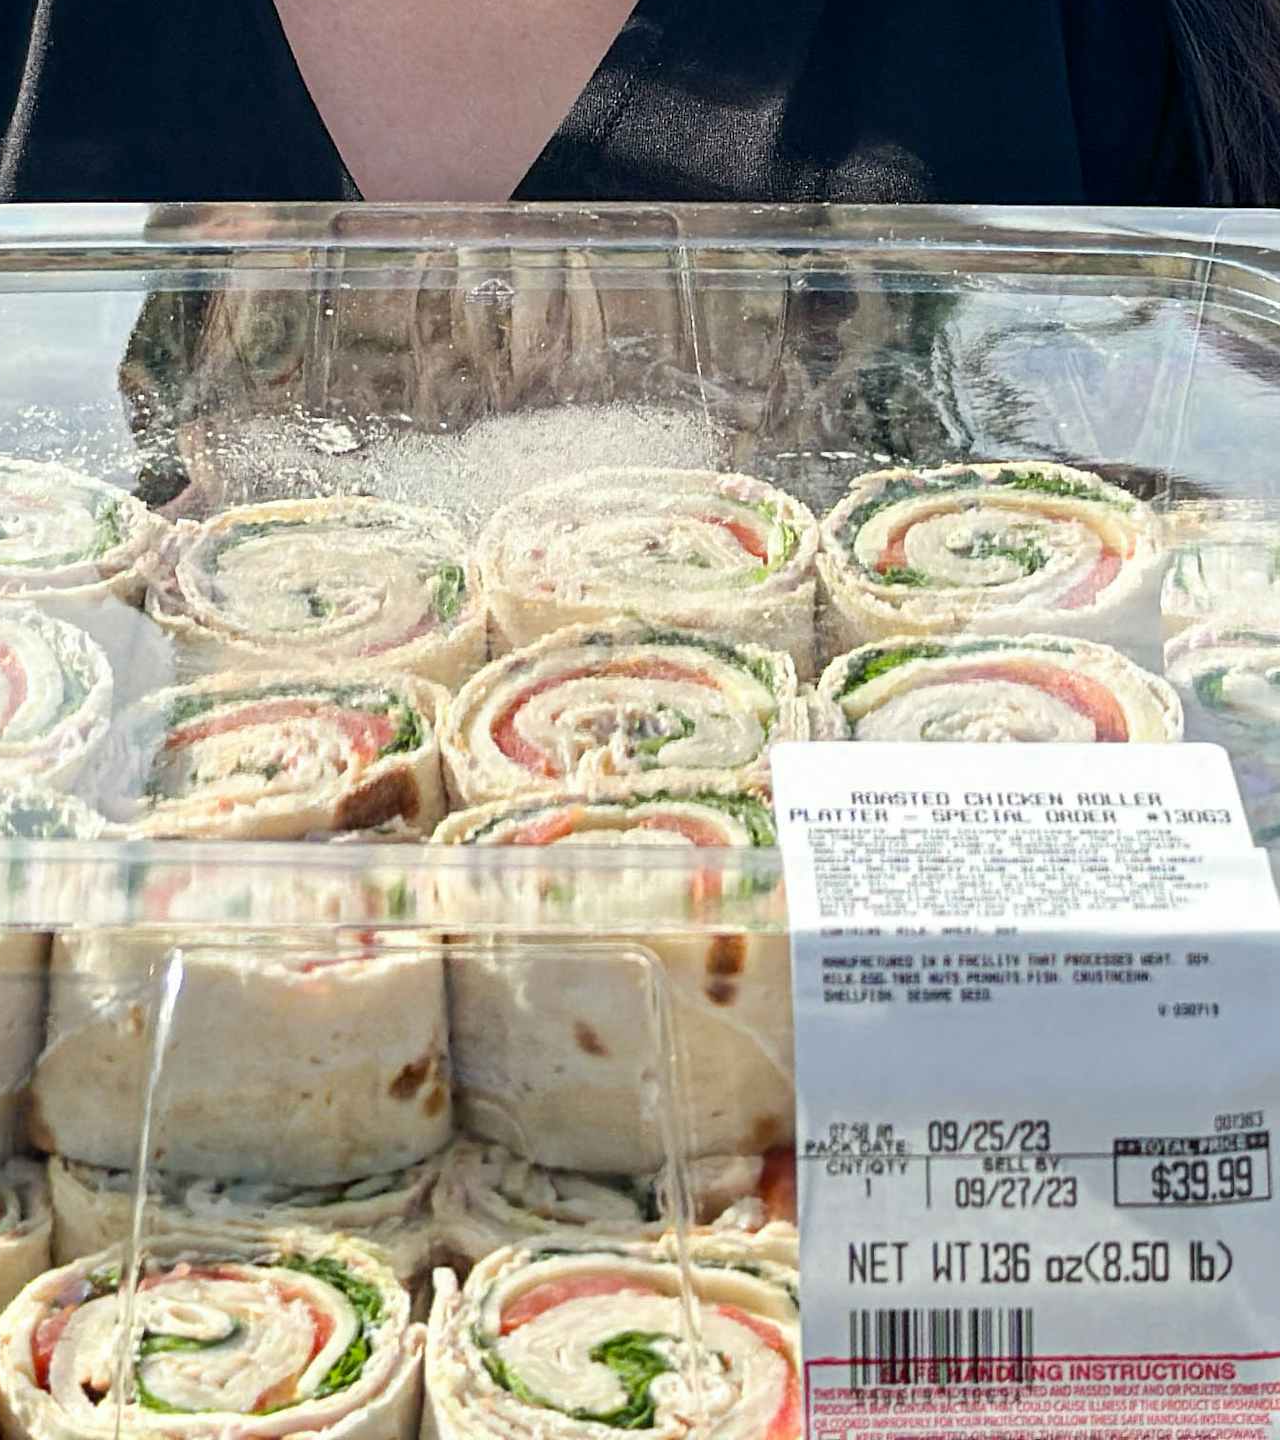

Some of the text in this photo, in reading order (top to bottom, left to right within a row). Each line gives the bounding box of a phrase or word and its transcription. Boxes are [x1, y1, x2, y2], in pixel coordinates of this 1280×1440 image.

[850, 791, 1163, 807] ROASTED CHICKEN ROLLER
[788, 808, 889, 823] PLATTER
[931, 809, 1031, 824] SPECIAL
[1045, 809, 1118, 824] ORDER
[928, 1120, 1051, 1153] 09/25/23
[983, 1157, 1026, 1172] SELL
[1151, 1155, 1253, 1203] $39.99
[955, 1176, 1077, 1209] 09/27/23
[849, 1242, 909, 1283] NET
[1189, 1240, 1233, 1283] lb)
[1070, 1361, 1236, 1381] INSTRUCTIONS
